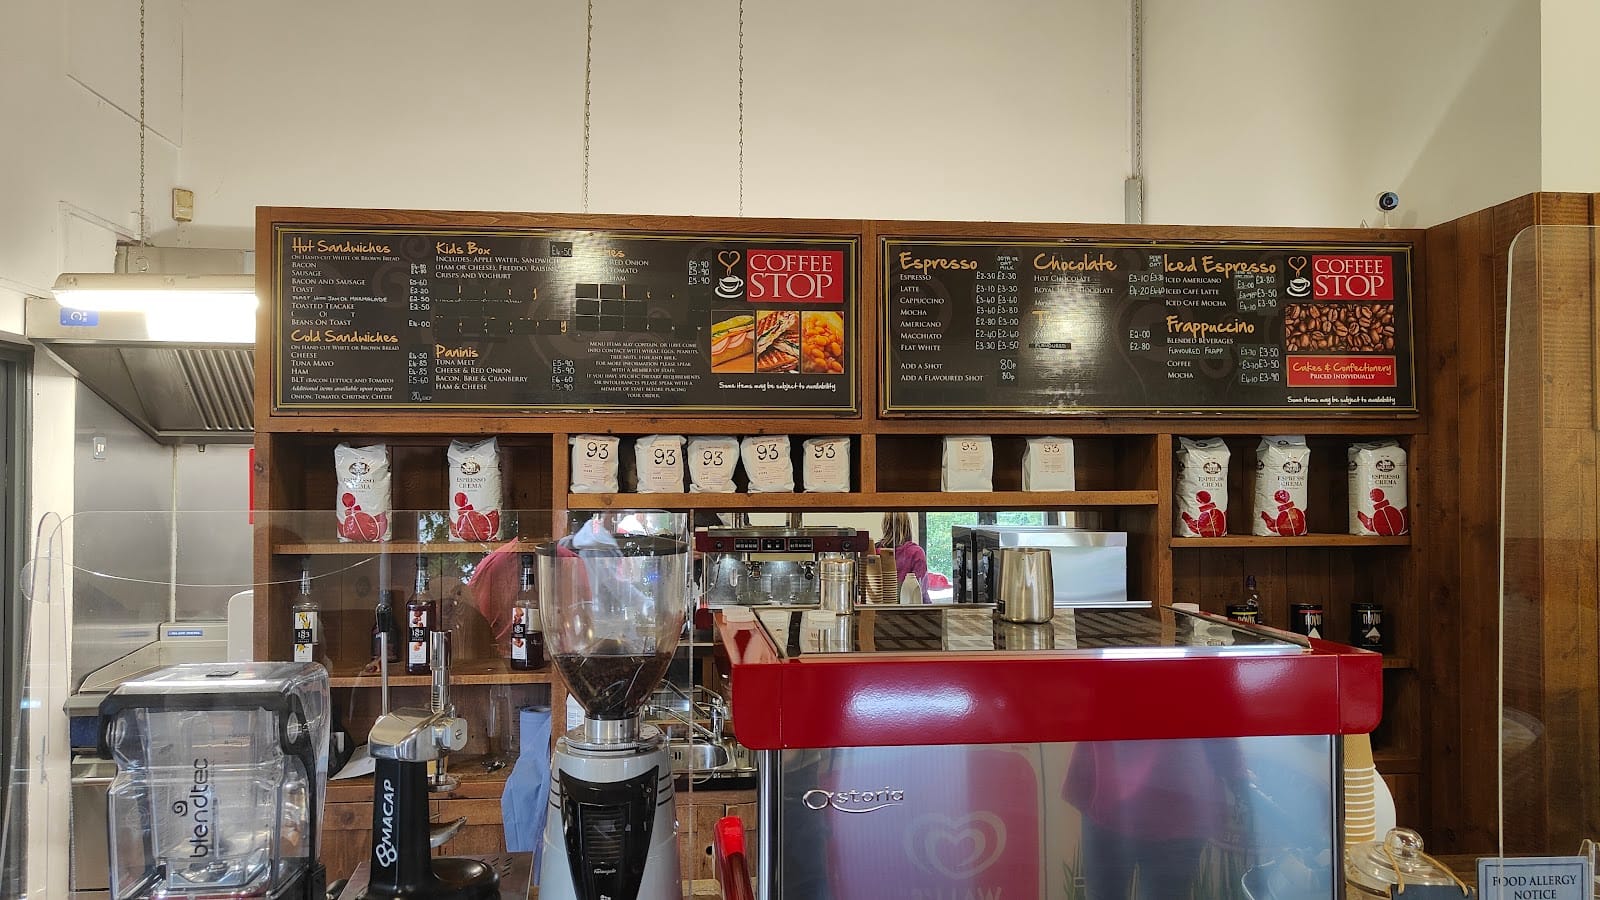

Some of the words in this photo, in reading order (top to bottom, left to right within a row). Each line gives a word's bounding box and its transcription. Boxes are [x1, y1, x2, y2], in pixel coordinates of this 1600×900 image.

[292, 238, 314, 254] Hot
[317, 238, 391, 254] Sandwiches
[436, 242, 464, 254] Kids
[467, 242, 490, 254] Box
[750, 254, 832, 272] COFFEE
[899, 252, 978, 274] Espresso
[1034, 253, 1117, 271] Chocolate
[1164, 254, 1197, 272] Iced
[1202, 256, 1276, 278] Espresso
[1314, 259, 1384, 274] COFFEE
[750, 273, 833, 298] STOP
[1316, 275, 1384, 296] STOP
[1166, 315, 1254, 338] Frappuccino
[291, 330, 320, 342] Cold
[325, 330, 398, 342] Sandwiches
[436, 344, 479, 358] Paninis
[1293, 362, 1322, 372] Cakes
[1333, 362, 1391, 375] Confectionery
[587, 442, 608, 459] 93
[757, 444, 778, 460] 93
[815, 444, 835, 458] 93
[961, 442, 978, 450] 93
[1043, 444, 1060, 453] 93
[654, 449, 675, 465] 93
[703, 450, 723, 465] 93
[190, 758, 209, 858] blendtec
[382, 778, 398, 848] MACAP
[1492, 875, 1526, 887] FOOD
[1530, 875, 1577, 887] ALLERGY
[1514, 890, 1556, 900] NOTICE
